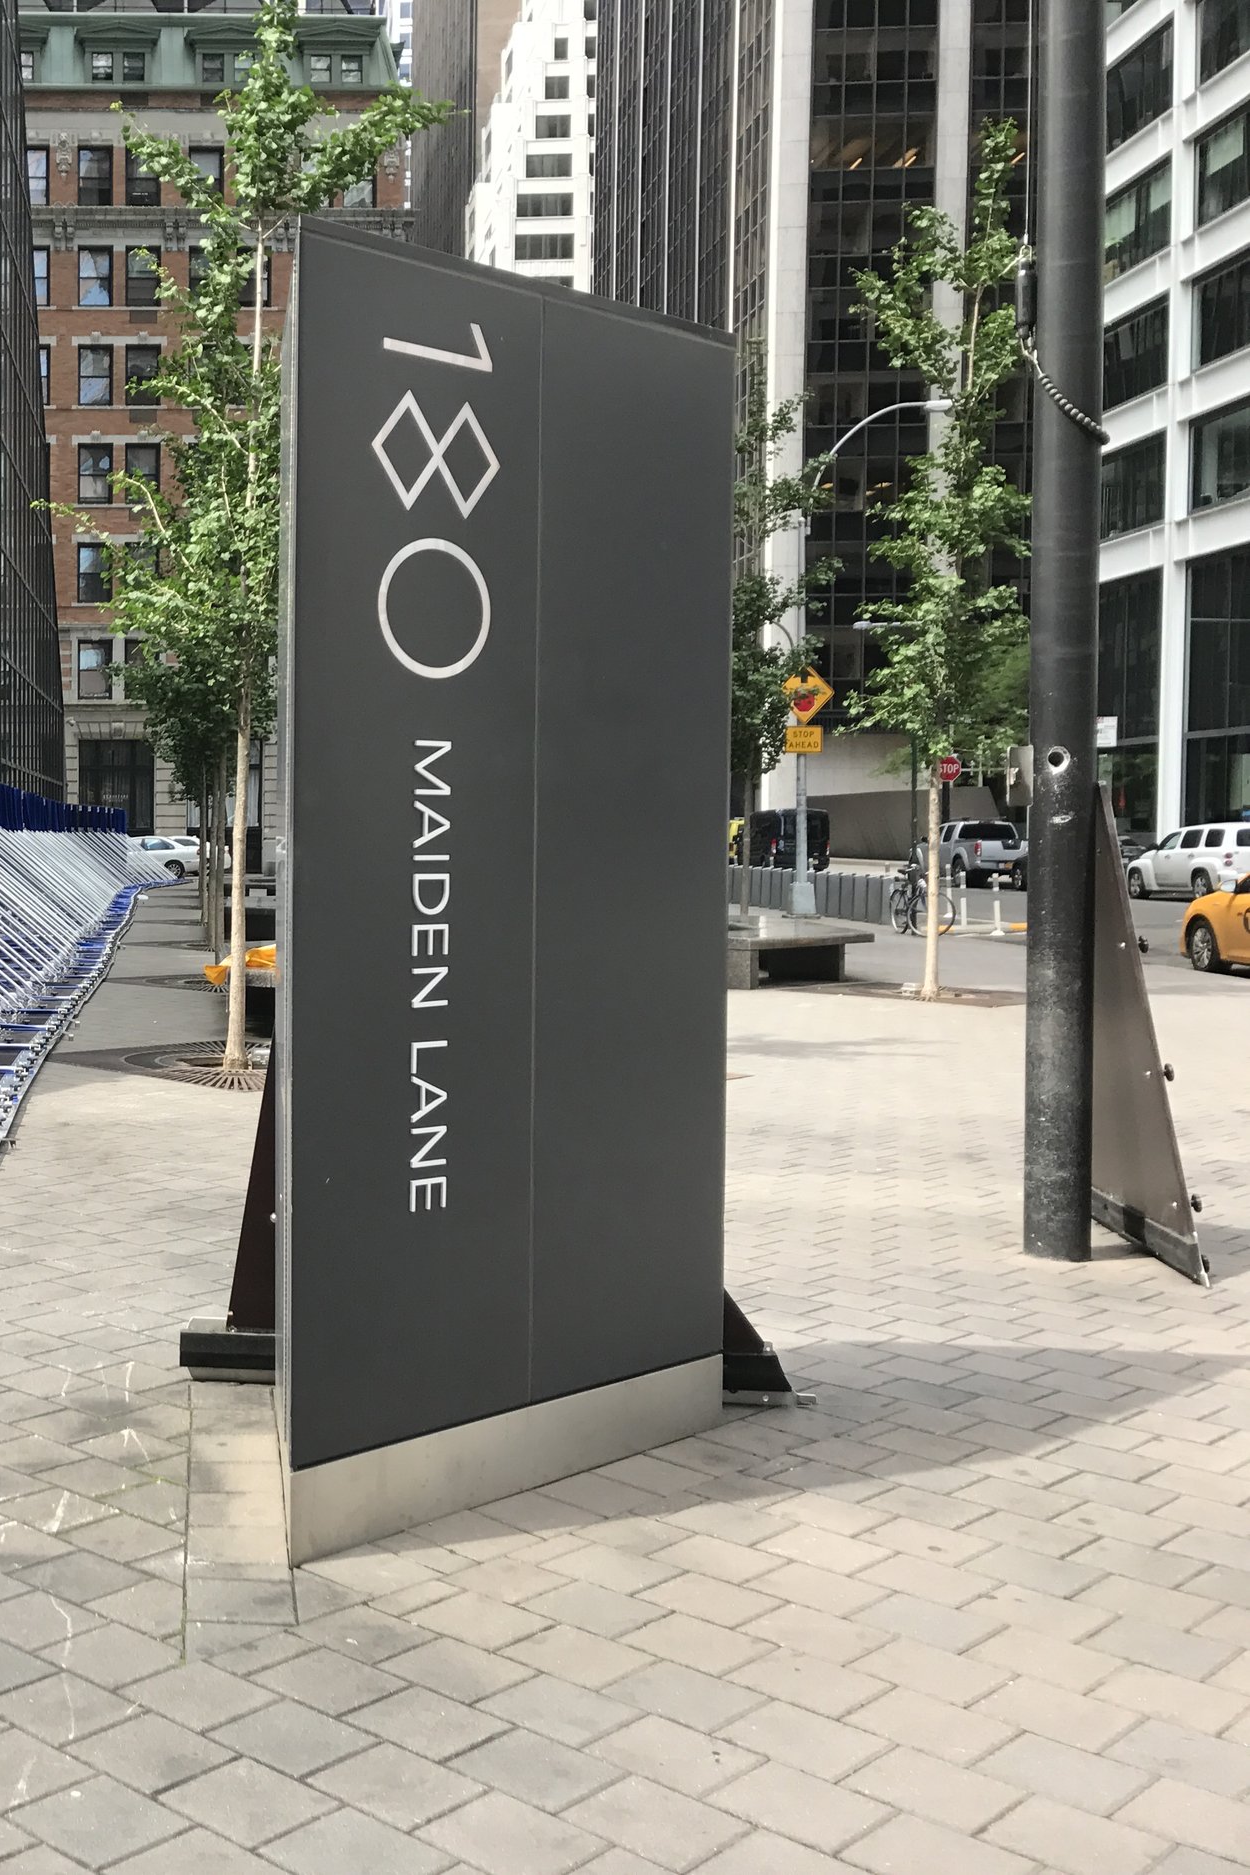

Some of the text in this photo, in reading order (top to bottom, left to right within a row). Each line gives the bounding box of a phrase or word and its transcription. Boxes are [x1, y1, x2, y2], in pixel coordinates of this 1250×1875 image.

[792, 730, 815, 738] STOP
[788, 741, 819, 749] AHEAD
[372, 322, 501, 1213] 180 MAIDEN LANE
